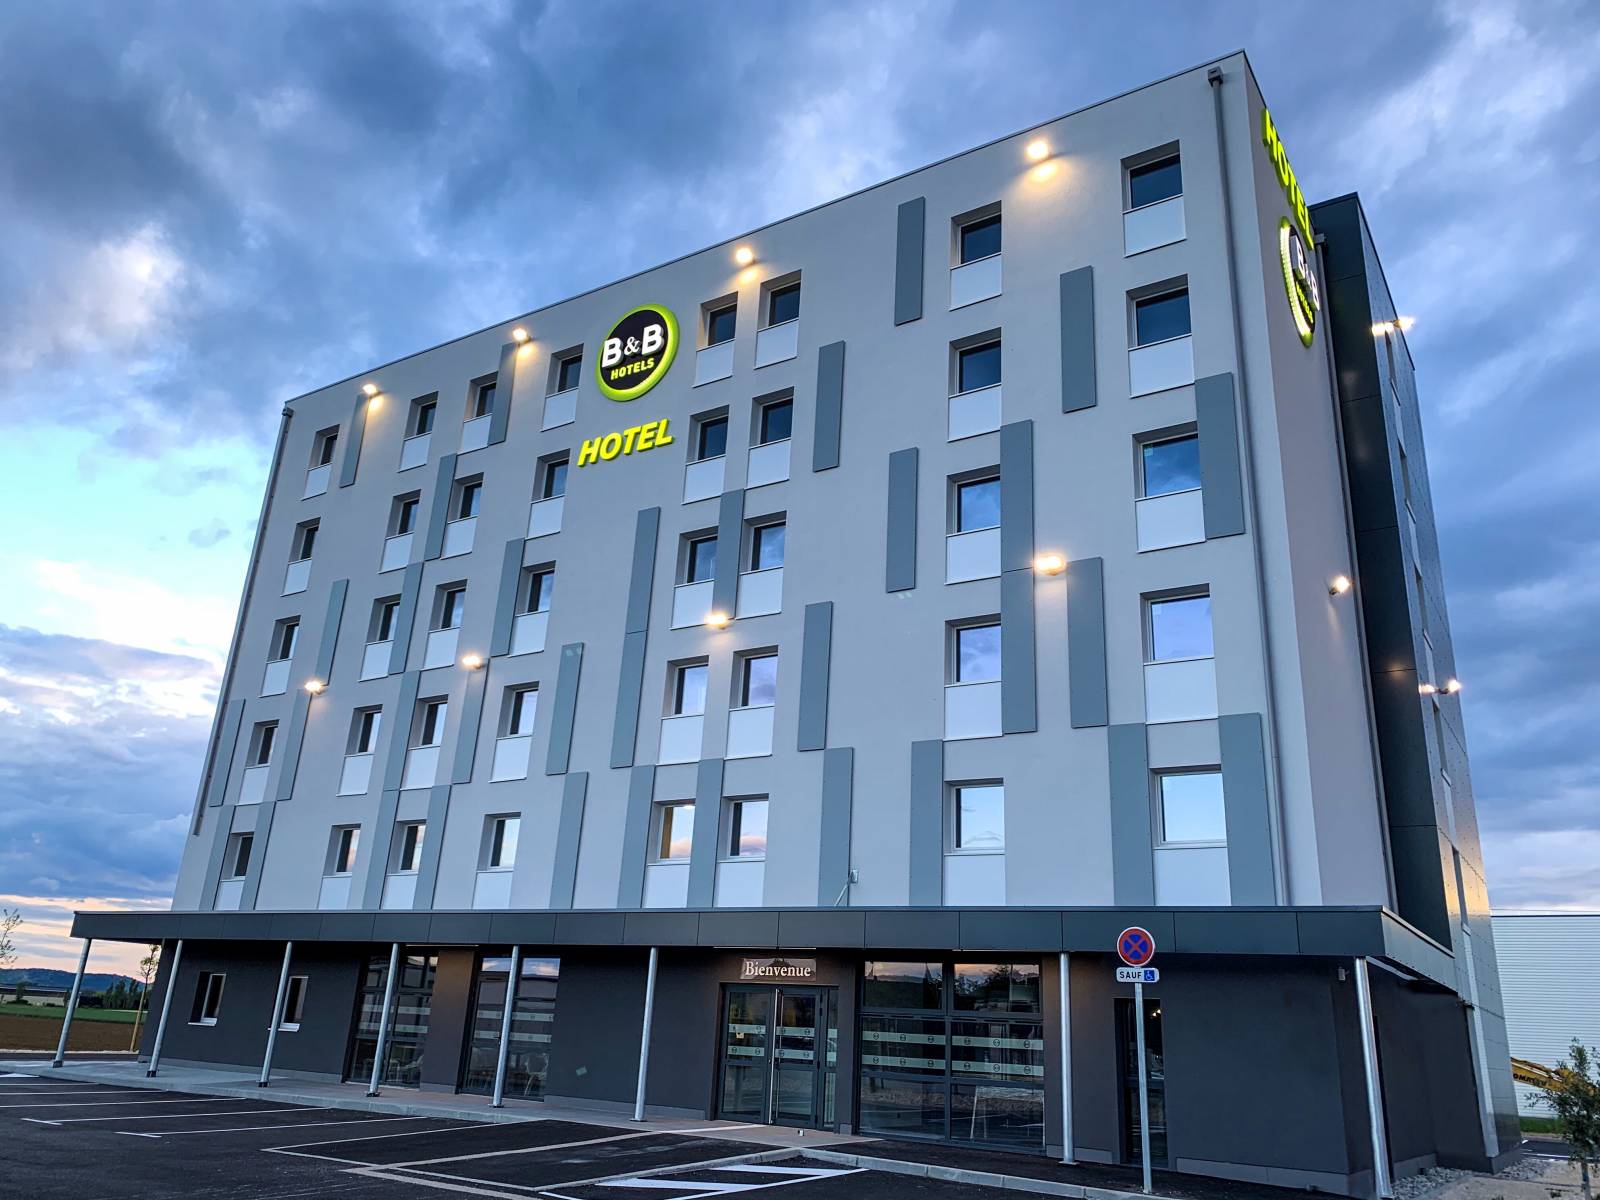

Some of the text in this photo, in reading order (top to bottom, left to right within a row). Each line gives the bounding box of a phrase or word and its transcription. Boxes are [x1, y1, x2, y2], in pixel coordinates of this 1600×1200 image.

[1261, 107, 1314, 250] HOTEL
[601, 323, 664, 368] B&B
[610, 357, 655, 381] HOTELS
[577, 418, 673, 467] HOTEL
[744, 961, 811, 977] Bienvenue
[1119, 971, 1142, 979] SAUF
